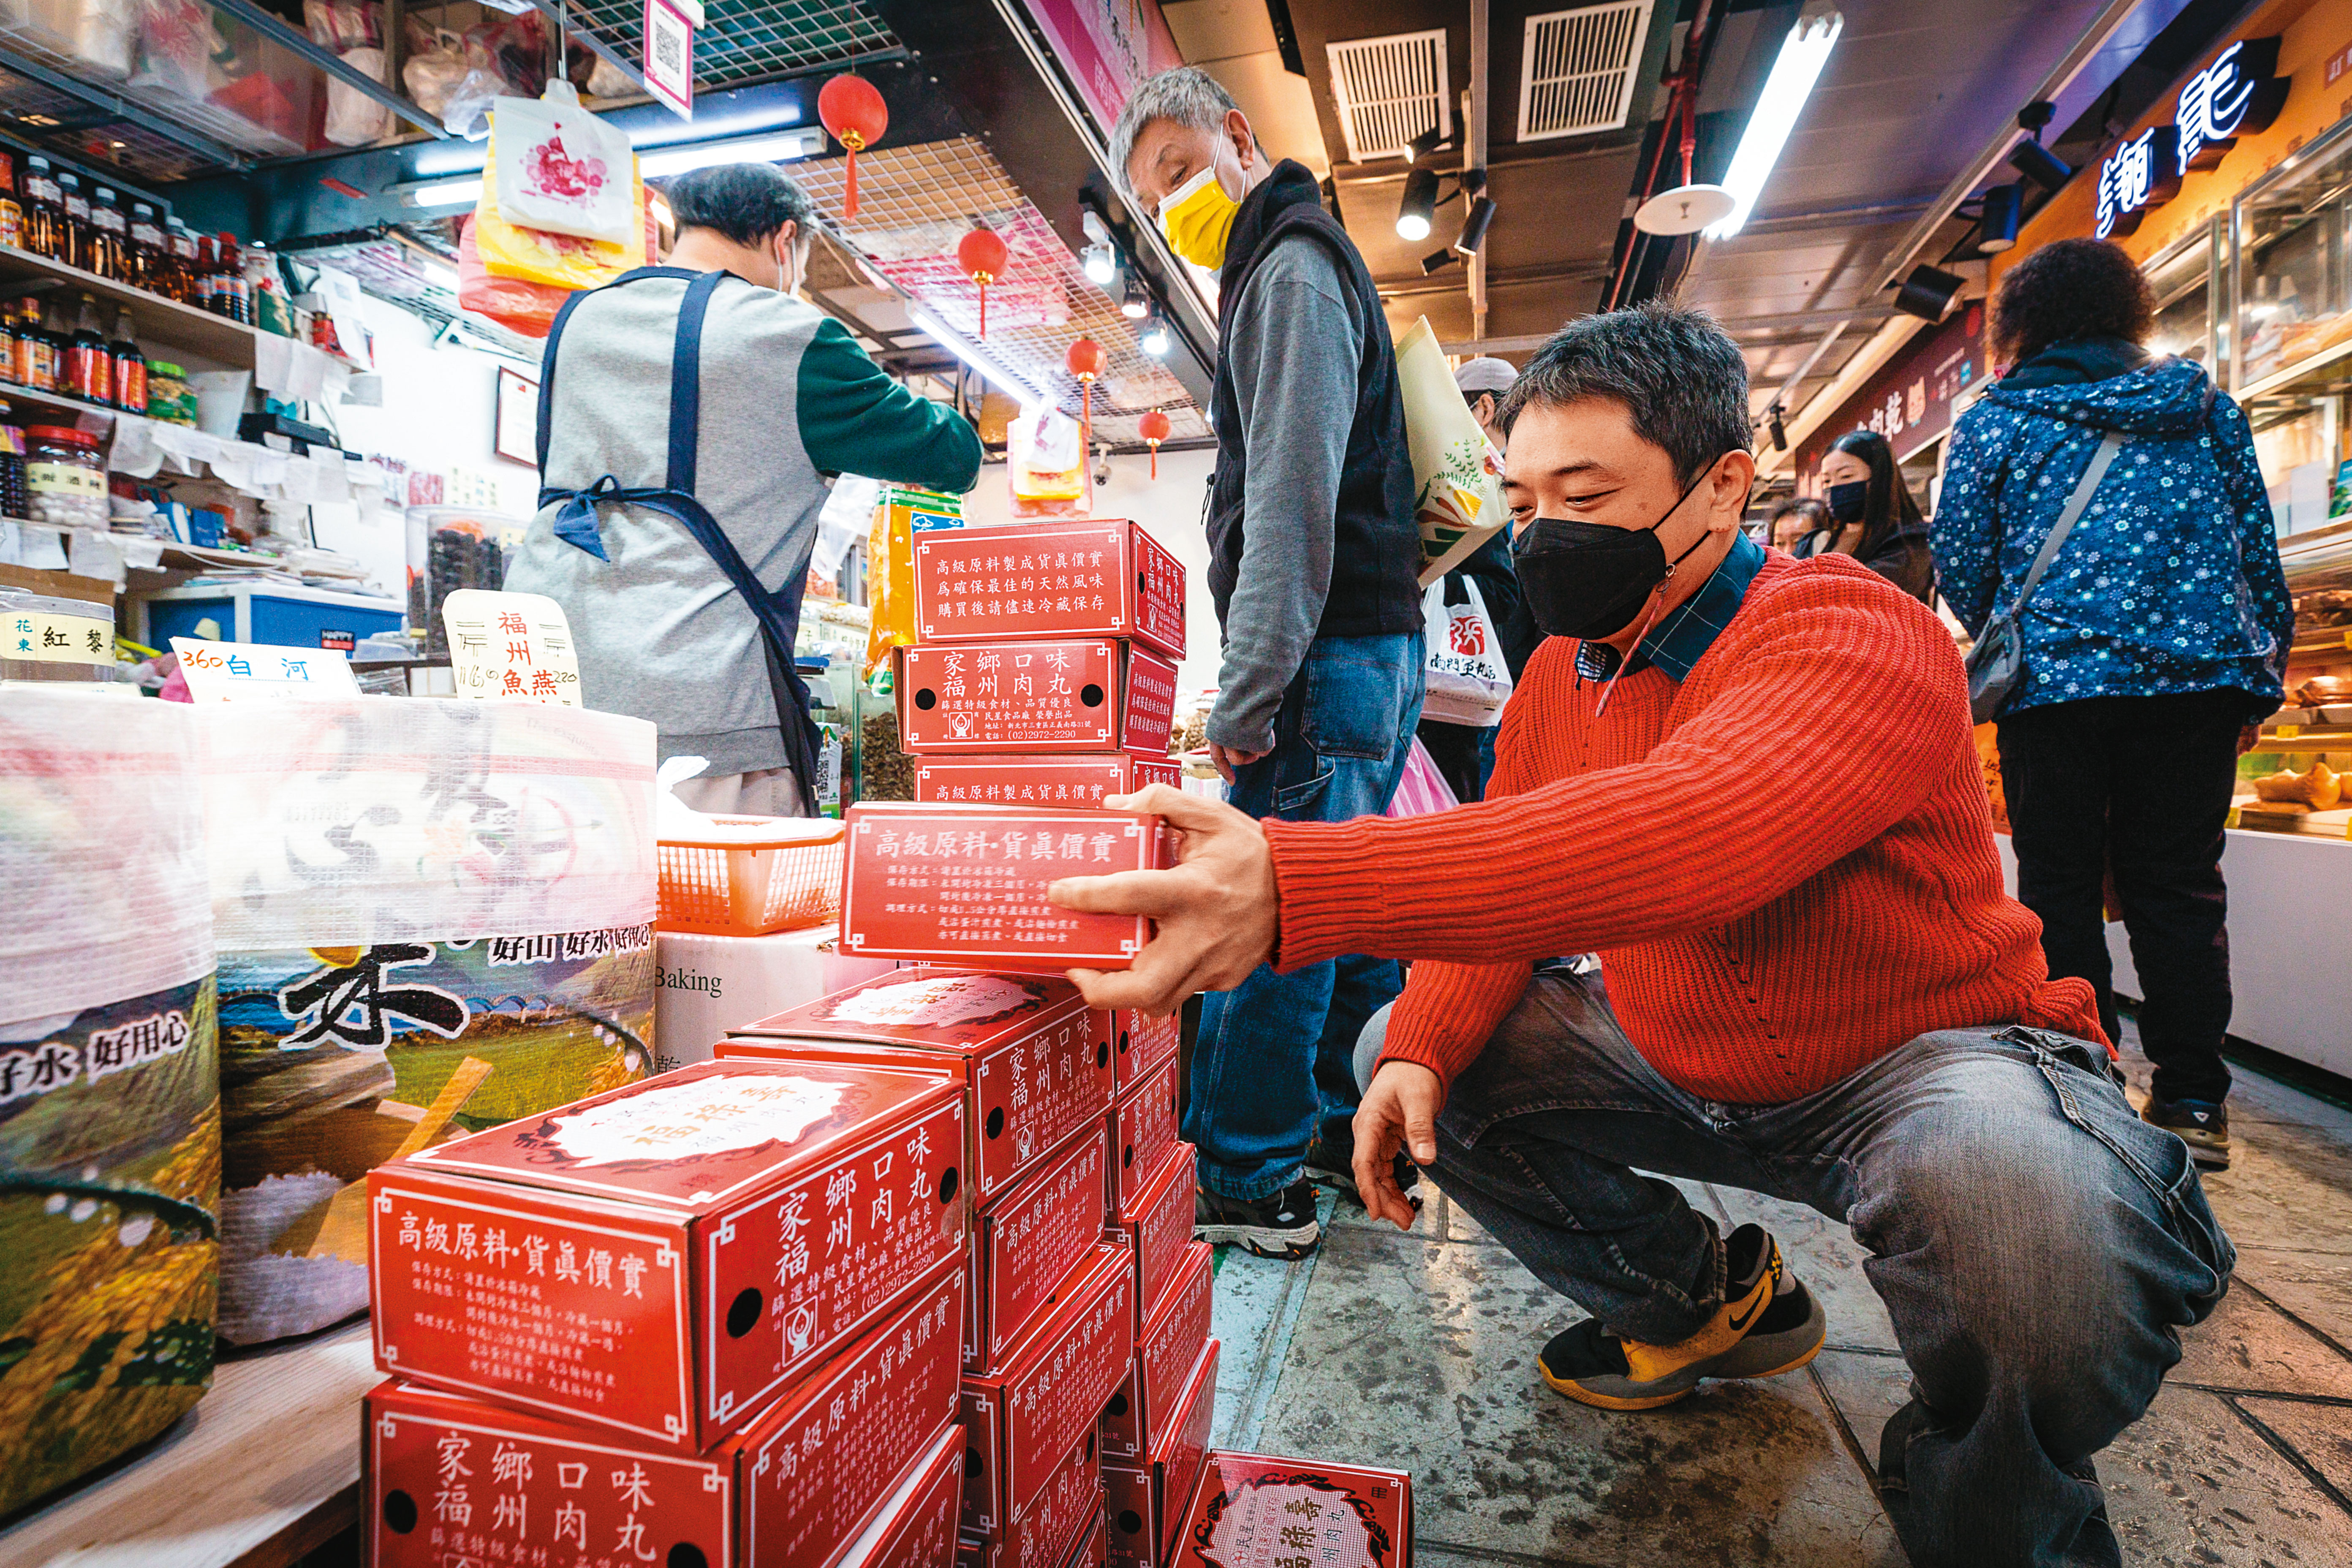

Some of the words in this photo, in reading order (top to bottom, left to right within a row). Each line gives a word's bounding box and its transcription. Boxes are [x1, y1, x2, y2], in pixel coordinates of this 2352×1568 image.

[1147, 544, 1179, 588] 家鄉口味
[1147, 567, 1179, 609] 福州肉丸
[938, 595, 1104, 617] 購買後請儘速冷藏保存
[15, 619, 33, 652] 花東
[498, 611, 531, 666] 福州
[183, 649, 223, 669] 360
[226, 655, 309, 681] 白河
[502, 669, 557, 696] 魚燕
[553, 671, 577, 683] 220
[942, 673, 1072, 698] 福州肉丸
[944, 648, 1071, 676] 家鄉口味
[985, 711, 1031, 721] 民星食品廠
[492, 936, 553, 962] 好山
[566, 930, 609, 957] 好水
[615, 924, 649, 951] 好用心
[655, 966, 722, 998] Baking
[95, 1014, 187, 1069] 好用心
[1010, 1013, 1092, 1080] 家鄉口味
[1010, 1042, 1094, 1111] 福州肉丸
[1134, 1071, 1169, 1124] 家鄉口味
[1134, 1094, 1170, 1147] 福州肉丸
[778, 1127, 932, 1244] 家鄉口味
[773, 1168, 932, 1287] 福州肉丸
[834, 1250, 888, 1298] 民星食品廠
[862, 1231, 949, 1294] 新北市三重區正義南路31
[862, 1251, 934, 1313] (02)2972-2290
[436, 1431, 655, 1513] 家鄉口味
[432, 1480, 657, 1562] 福州肉丸
[1322, 1510, 1345, 1568] 州肉丸
